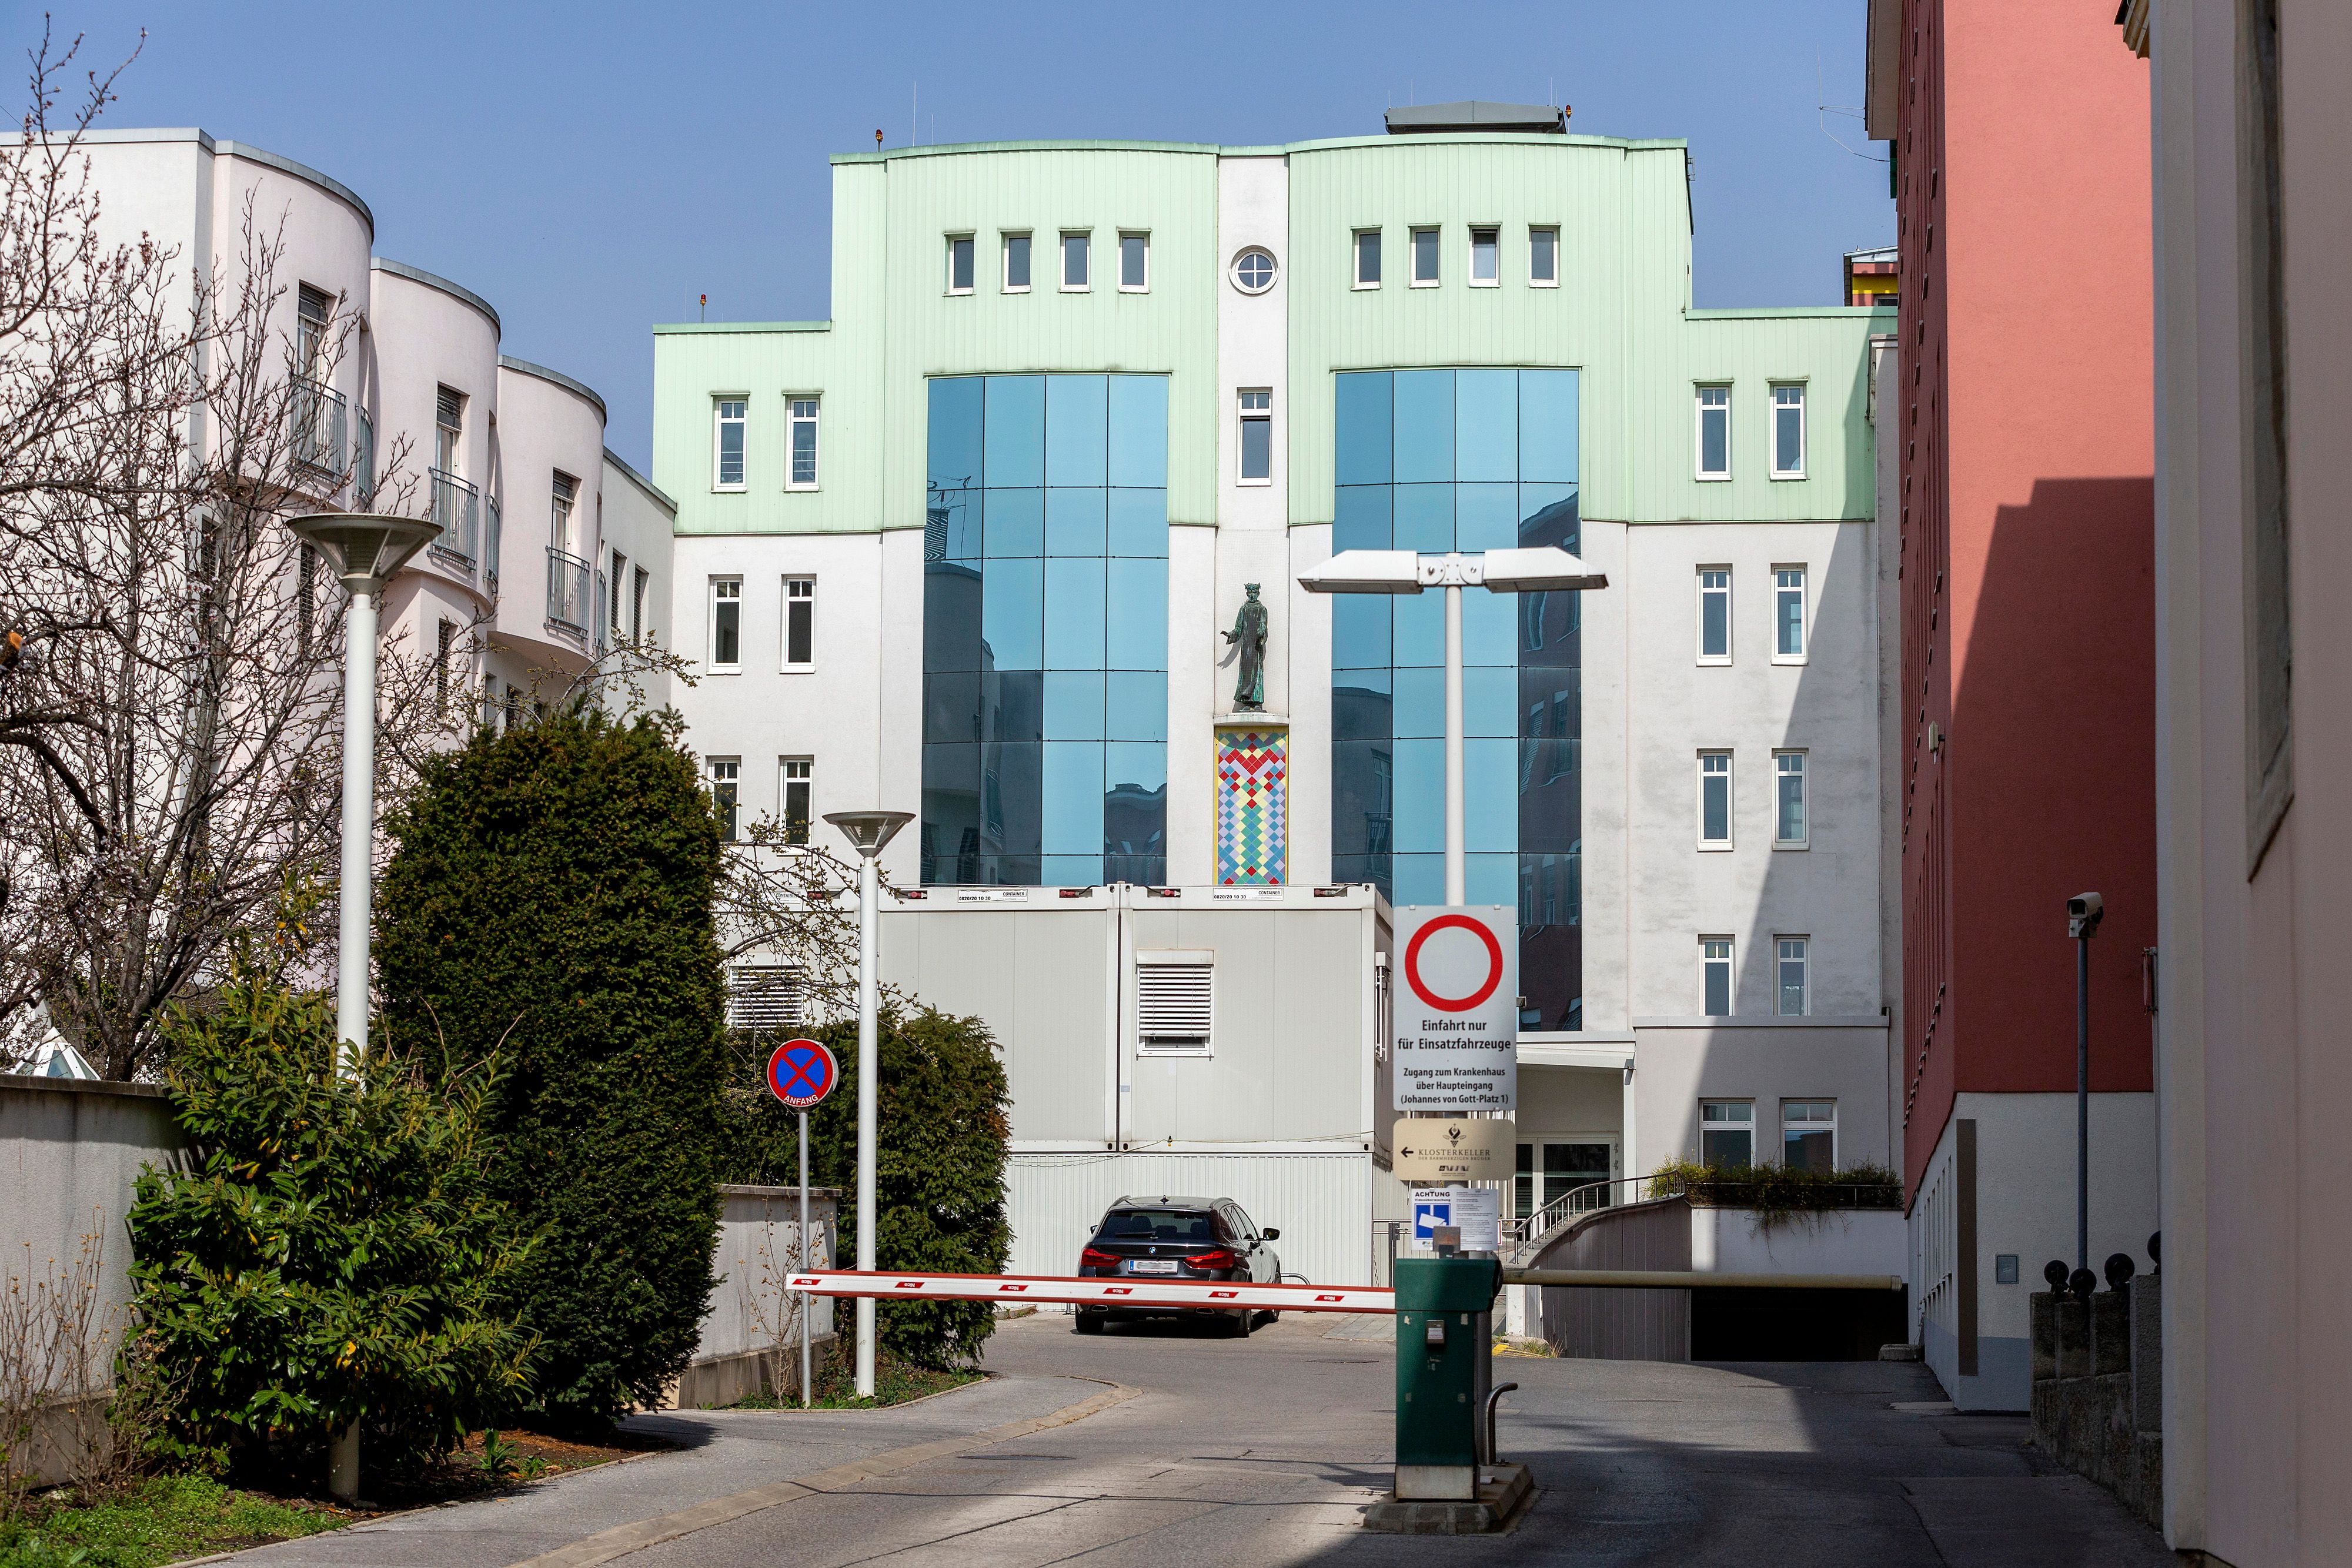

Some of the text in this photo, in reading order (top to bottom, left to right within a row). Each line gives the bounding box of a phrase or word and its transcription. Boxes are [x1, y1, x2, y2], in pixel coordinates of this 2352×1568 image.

[1422, 1019, 1487, 1031] Einfahrt nur
[1397, 1038, 1511, 1052] für Einsatzfahrzeuge
[1404, 1068, 1434, 1078] Zugang
[1454, 1068, 1505, 1076] Krankenhaus
[1416, 1081, 1493, 1091] über Haupteingang
[784, 1094, 818, 1105] ANFANG
[1401, 1095, 1441, 1104] (Johannes
[1458, 1094, 1499, 1103] Gott-Platz
[1501, 1094, 1509, 1104] 1)
